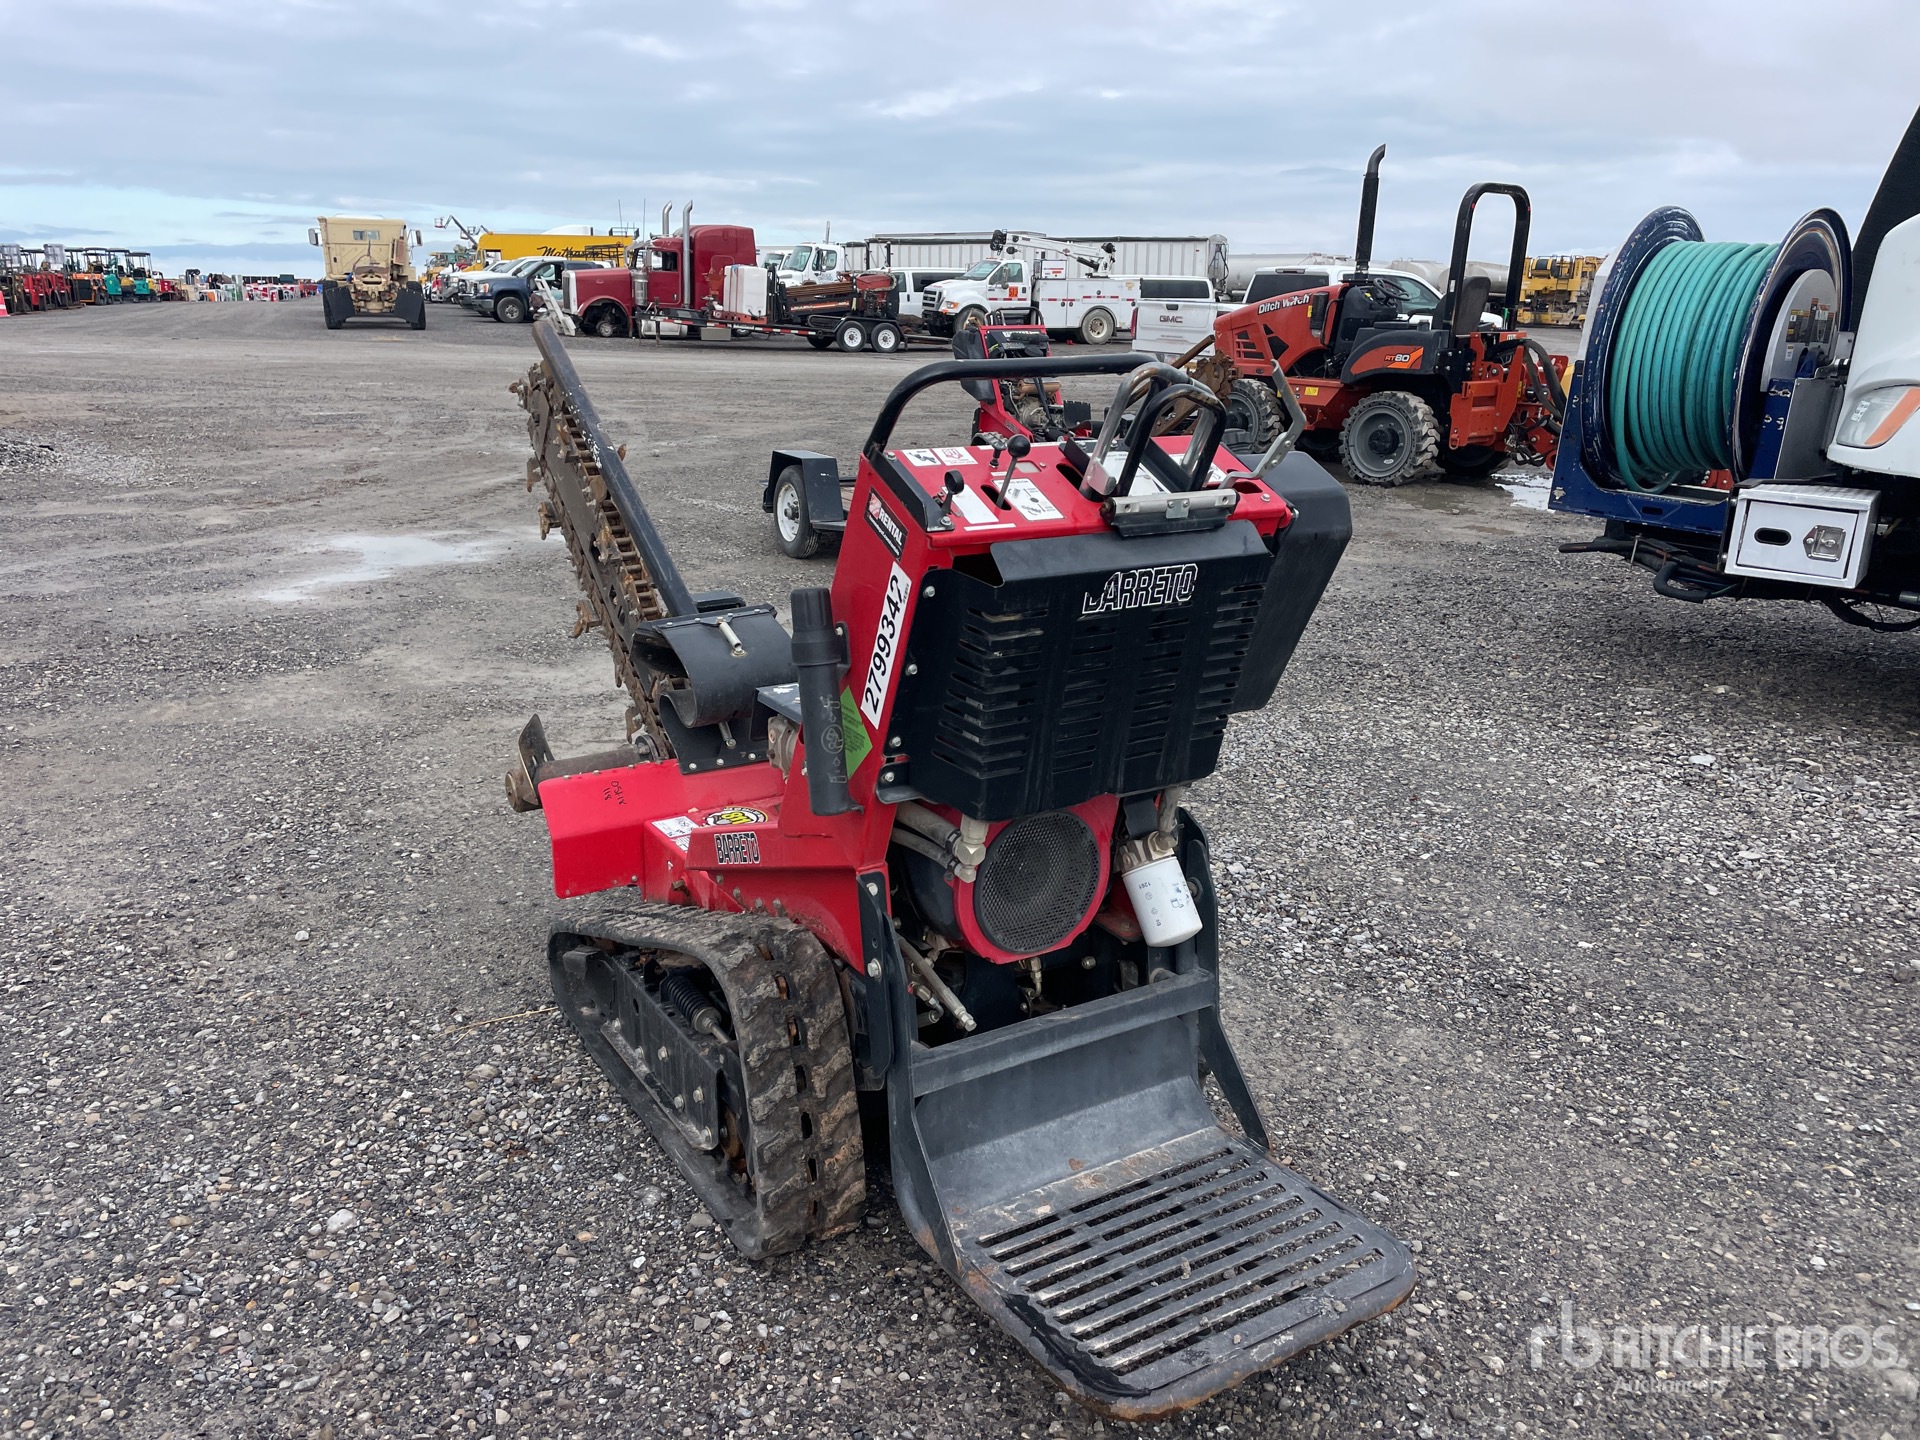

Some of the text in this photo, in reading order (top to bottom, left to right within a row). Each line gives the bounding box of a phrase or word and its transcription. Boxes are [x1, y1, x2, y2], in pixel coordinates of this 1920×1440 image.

[1159, 315, 1184, 323] GMC
[1258, 300, 1280, 314] Ditch
[1384, 353, 1410, 362] RT80
[878, 506, 903, 547] RENTAL
[864, 574, 903, 715] 2799342
[714, 831, 760, 865] BARRETO
